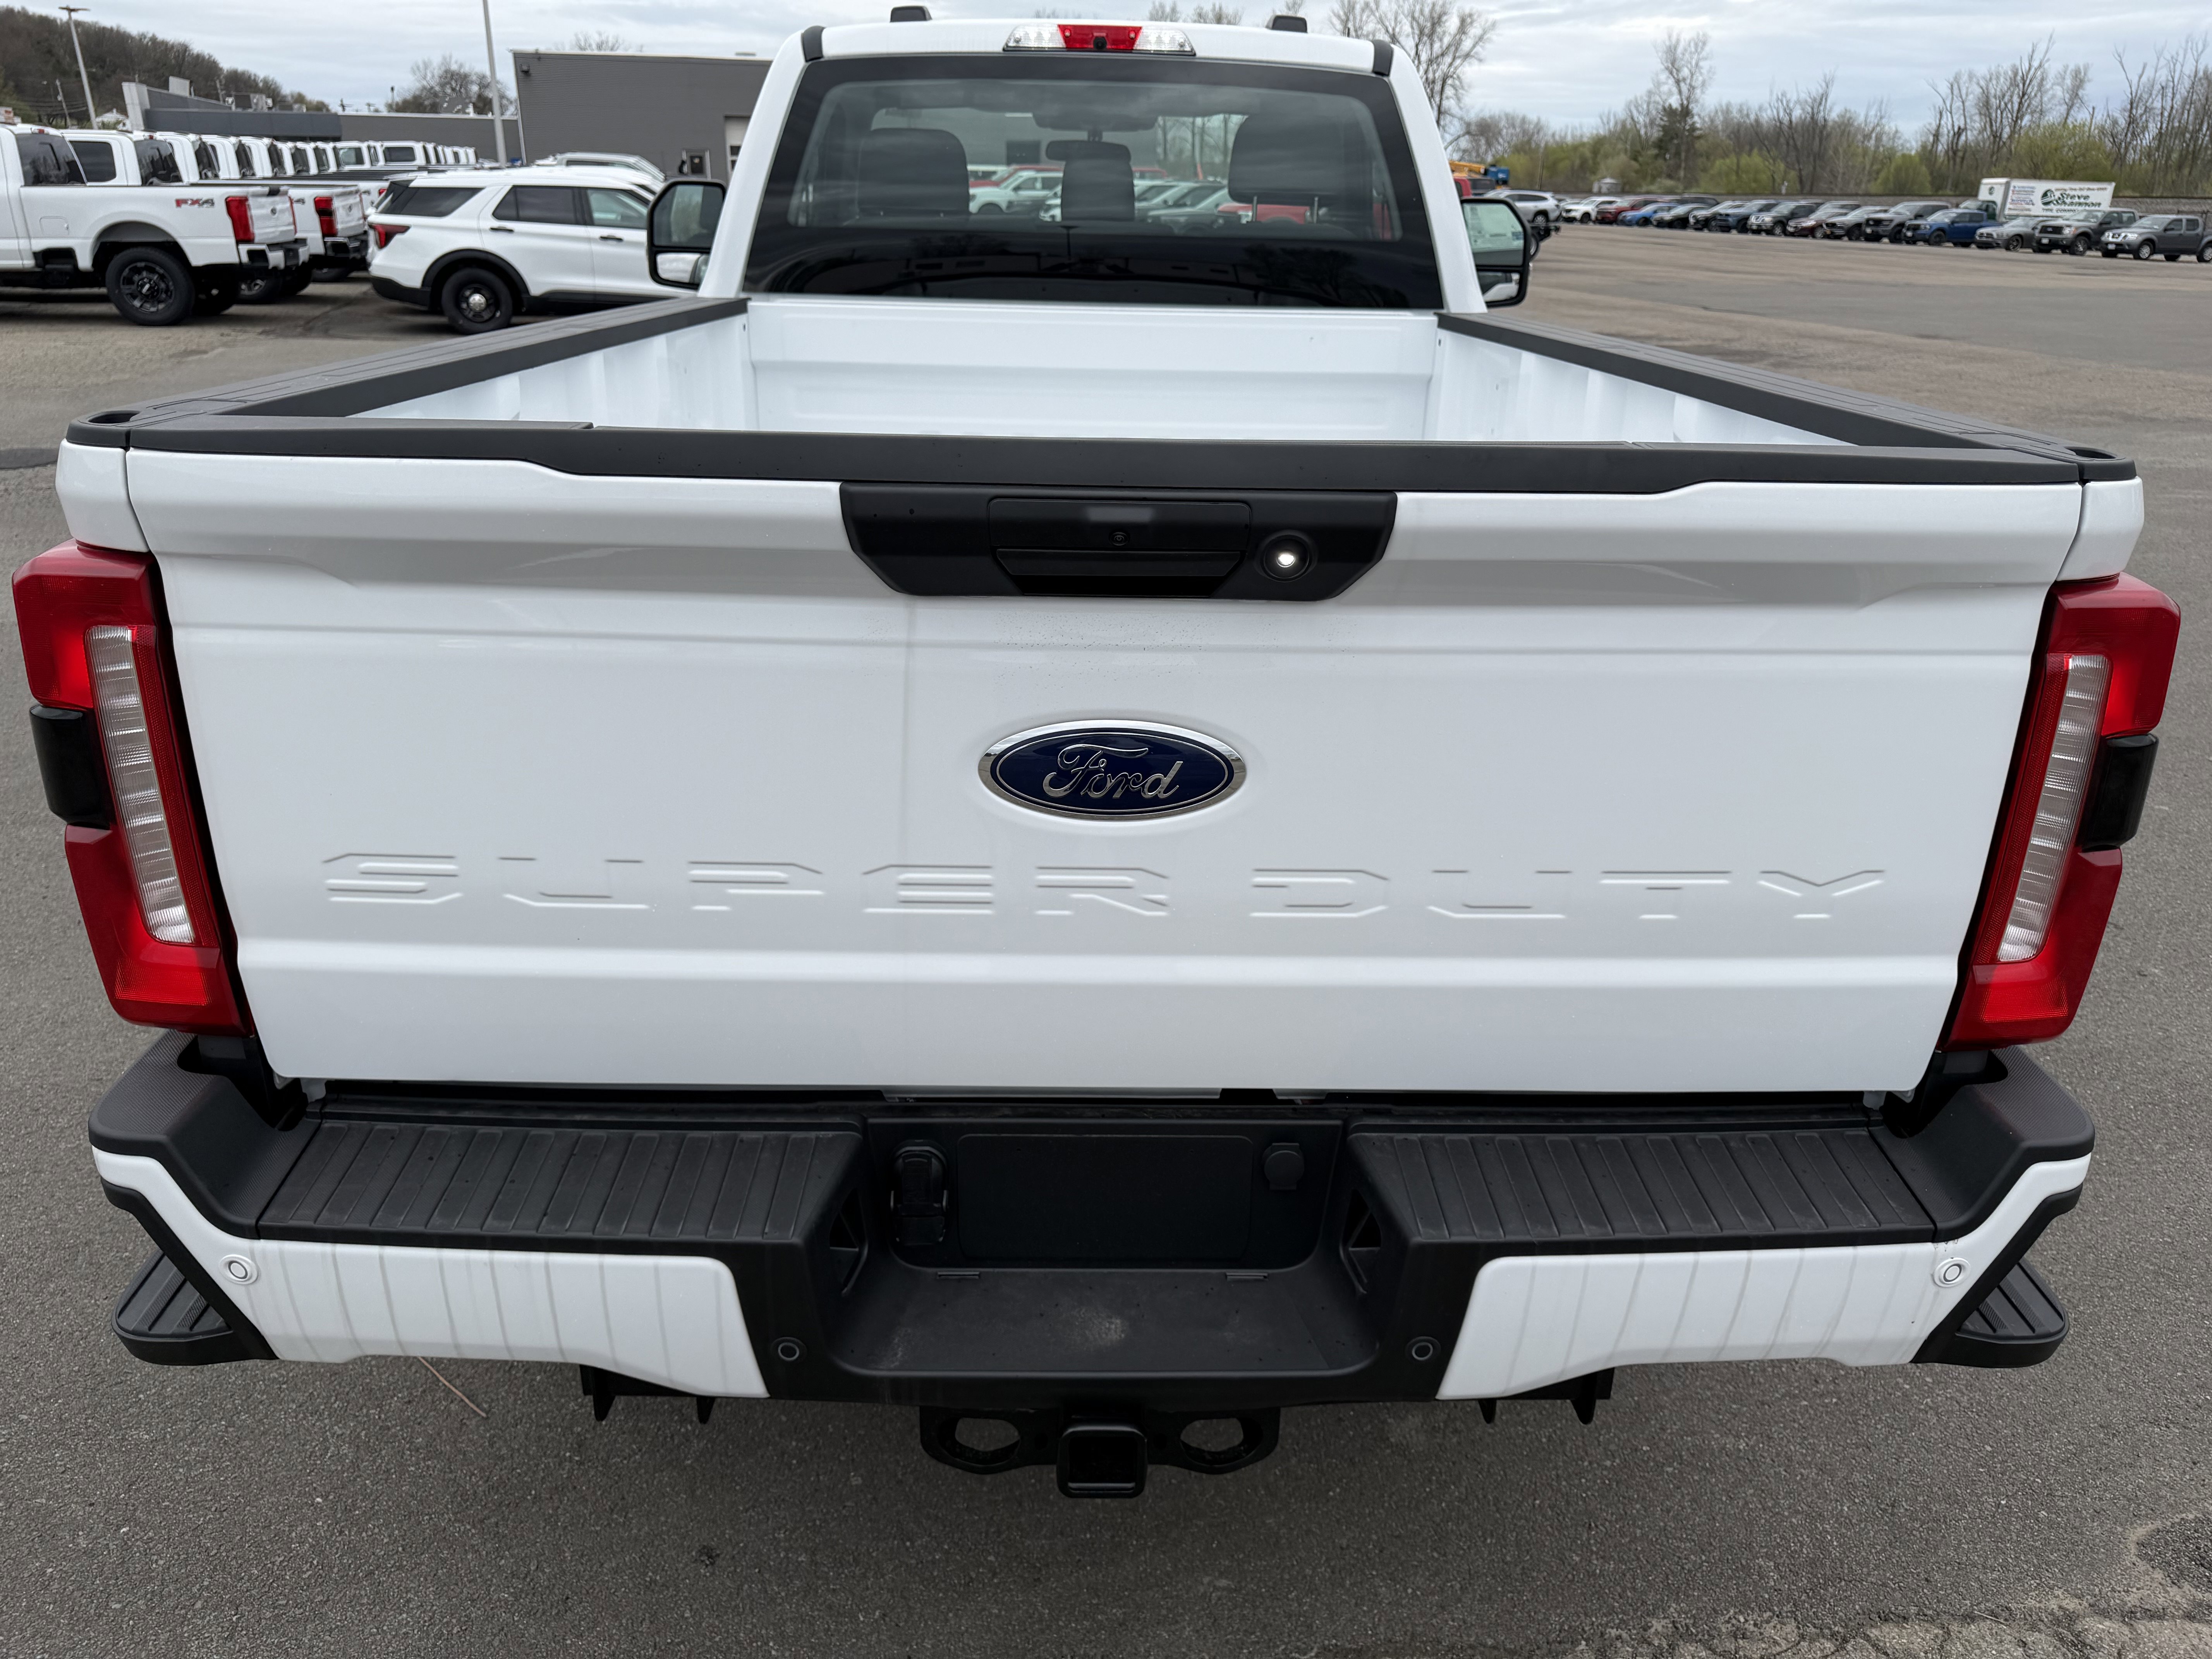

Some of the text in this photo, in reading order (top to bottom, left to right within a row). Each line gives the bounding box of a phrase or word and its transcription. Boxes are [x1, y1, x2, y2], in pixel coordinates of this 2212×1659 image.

[2058, 191, 2090, 201] Steve
[175, 198, 215, 208] FX4
[2052, 199, 2102, 208] Shannon
[1042, 744, 1183, 800] Ford
[322, 853, 1885, 919] SUPER DUTY
